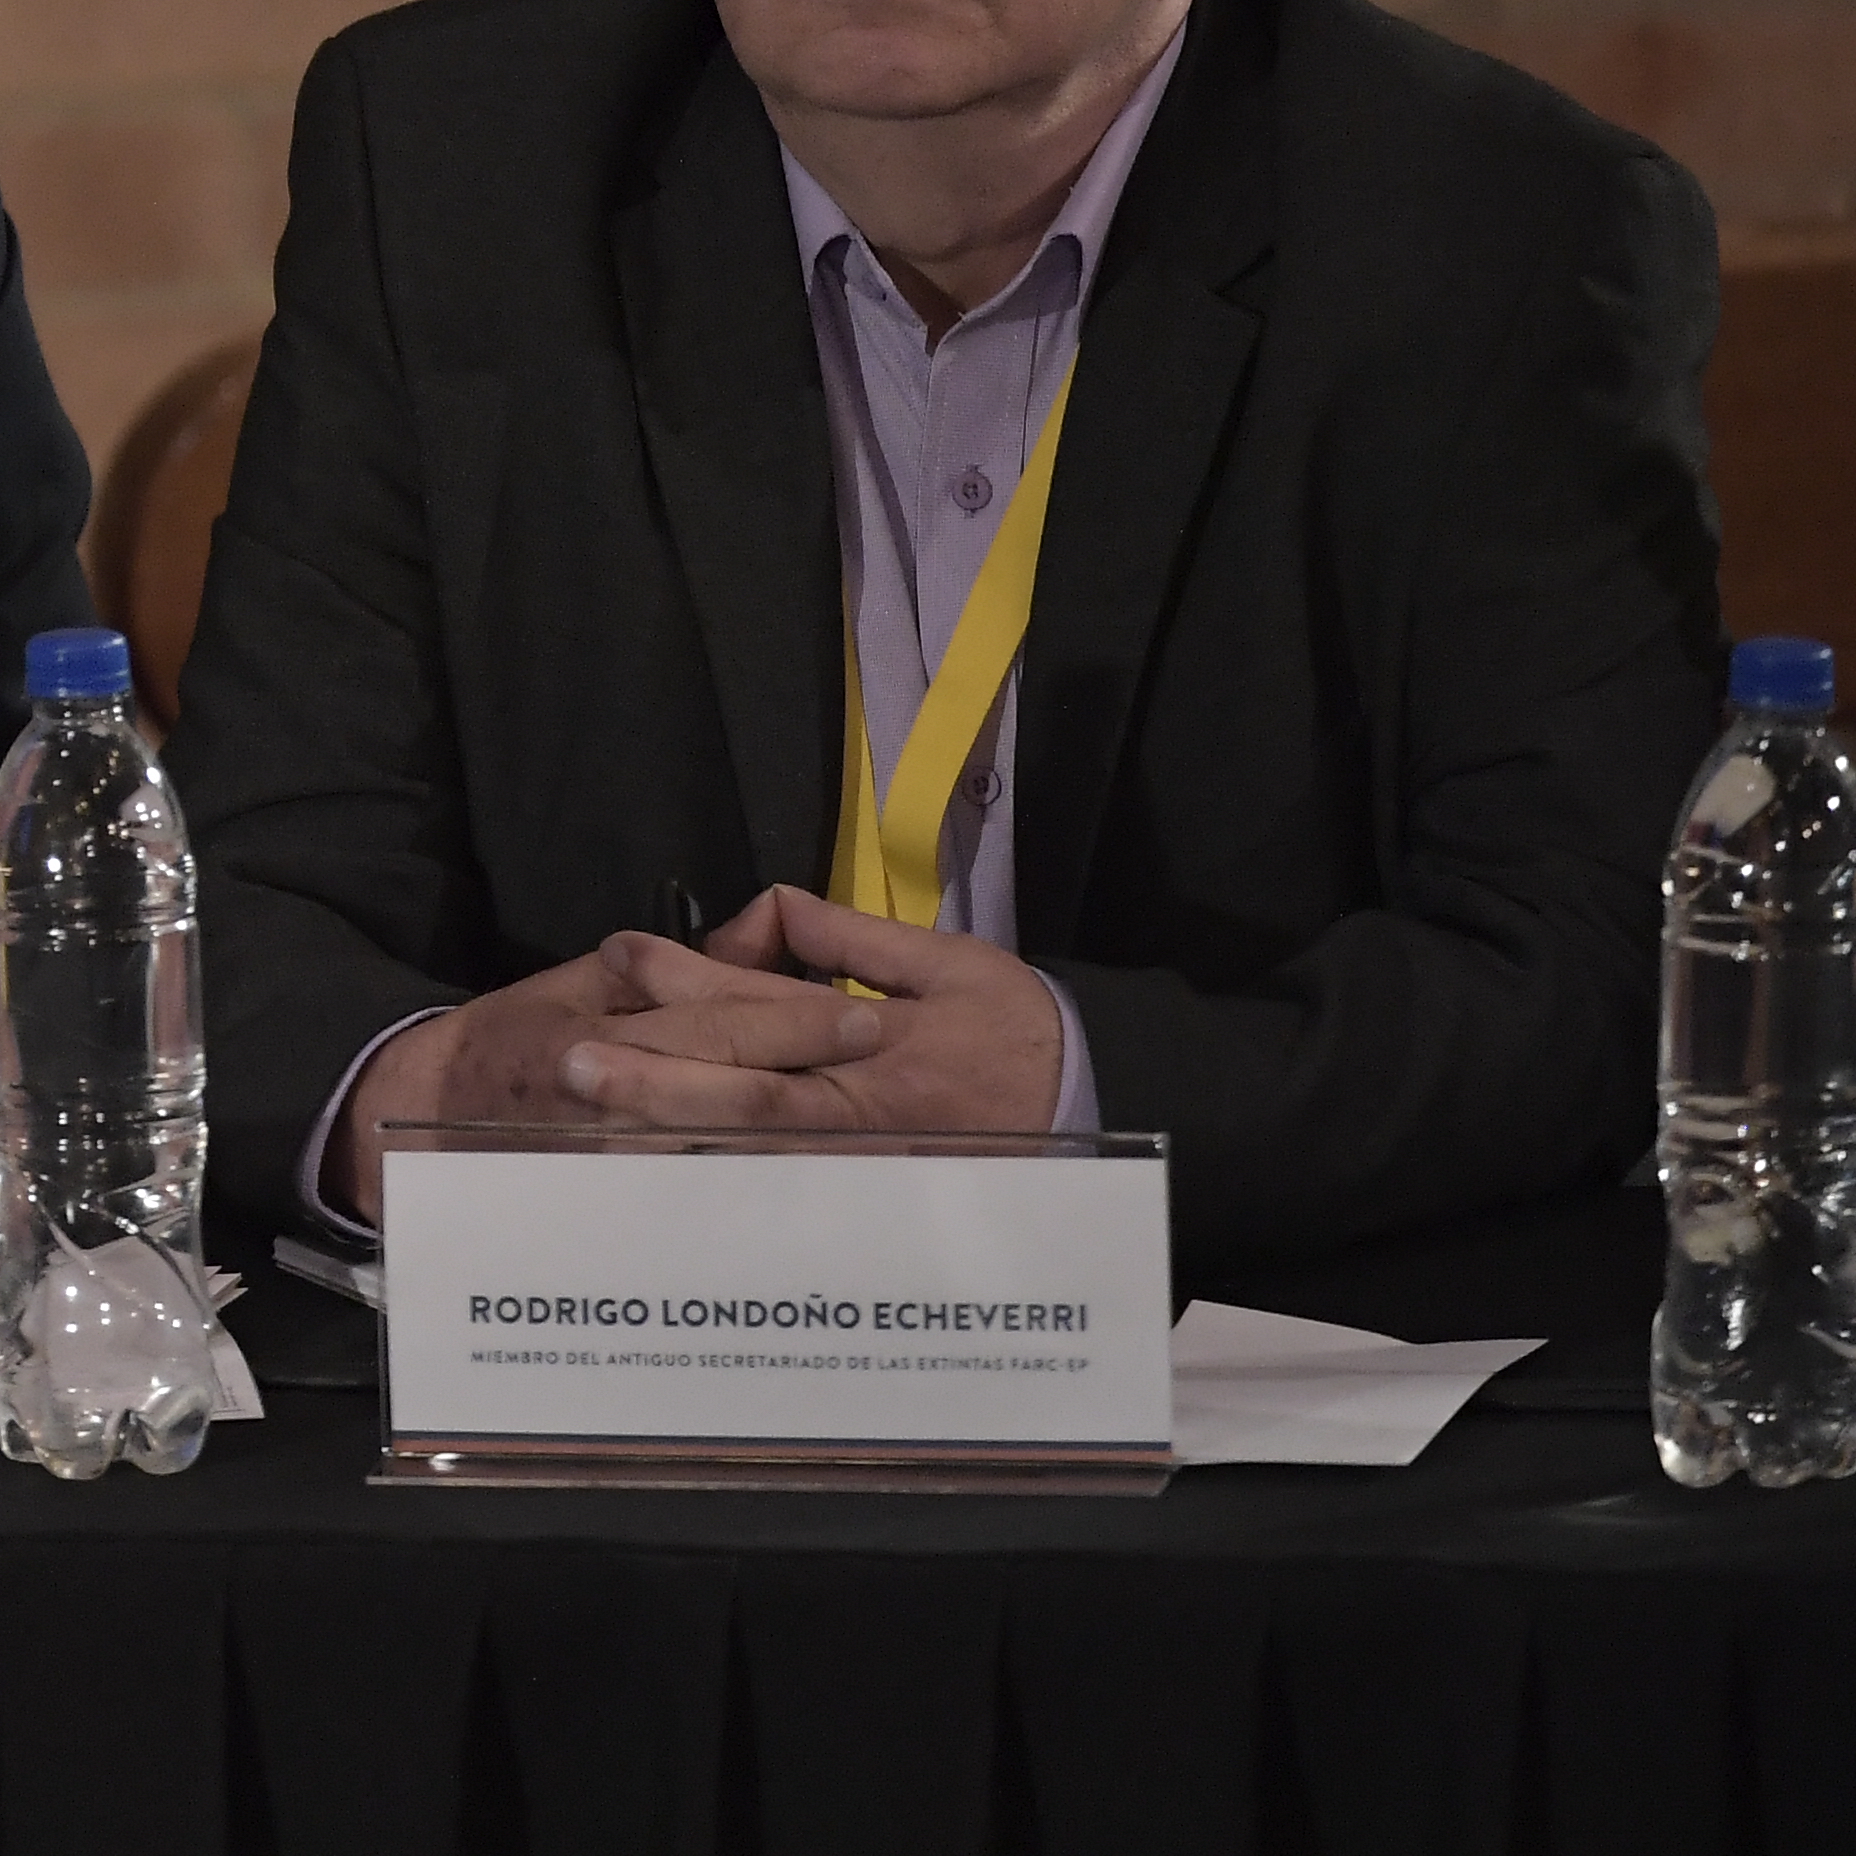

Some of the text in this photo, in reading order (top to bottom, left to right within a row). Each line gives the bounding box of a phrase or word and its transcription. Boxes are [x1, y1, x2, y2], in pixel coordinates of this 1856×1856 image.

[469, 1292, 1088, 1333] RODRIGO LONDOÑO ECHEVERRI
[470, 1349, 1088, 1372] MIEMBRO DEL ANTIGUO SECRETARIADO DE LAS EXTINTAS FARC-EP
